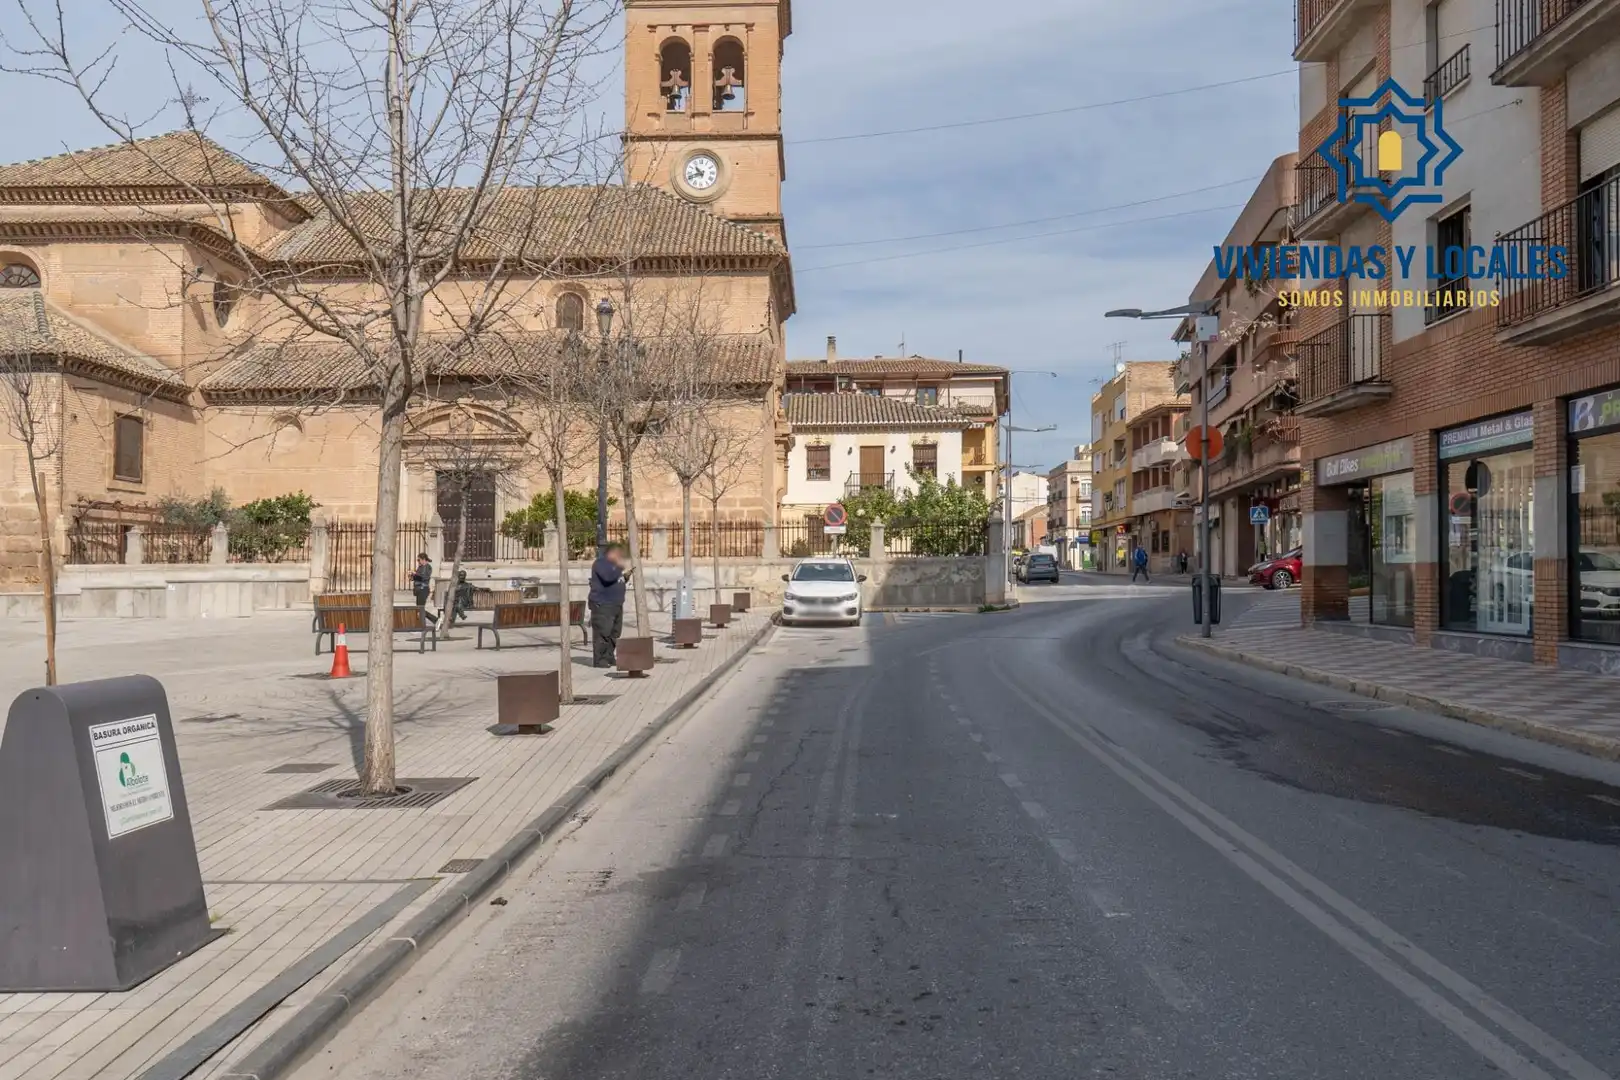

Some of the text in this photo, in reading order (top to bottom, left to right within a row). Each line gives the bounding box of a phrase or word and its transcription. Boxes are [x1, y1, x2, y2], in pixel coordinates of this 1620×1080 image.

[1442, 427, 1478, 445] PREMIUM
[1480, 421, 1503, 437] Metal
[93, 721, 156, 741] BASURA ORGANICA
